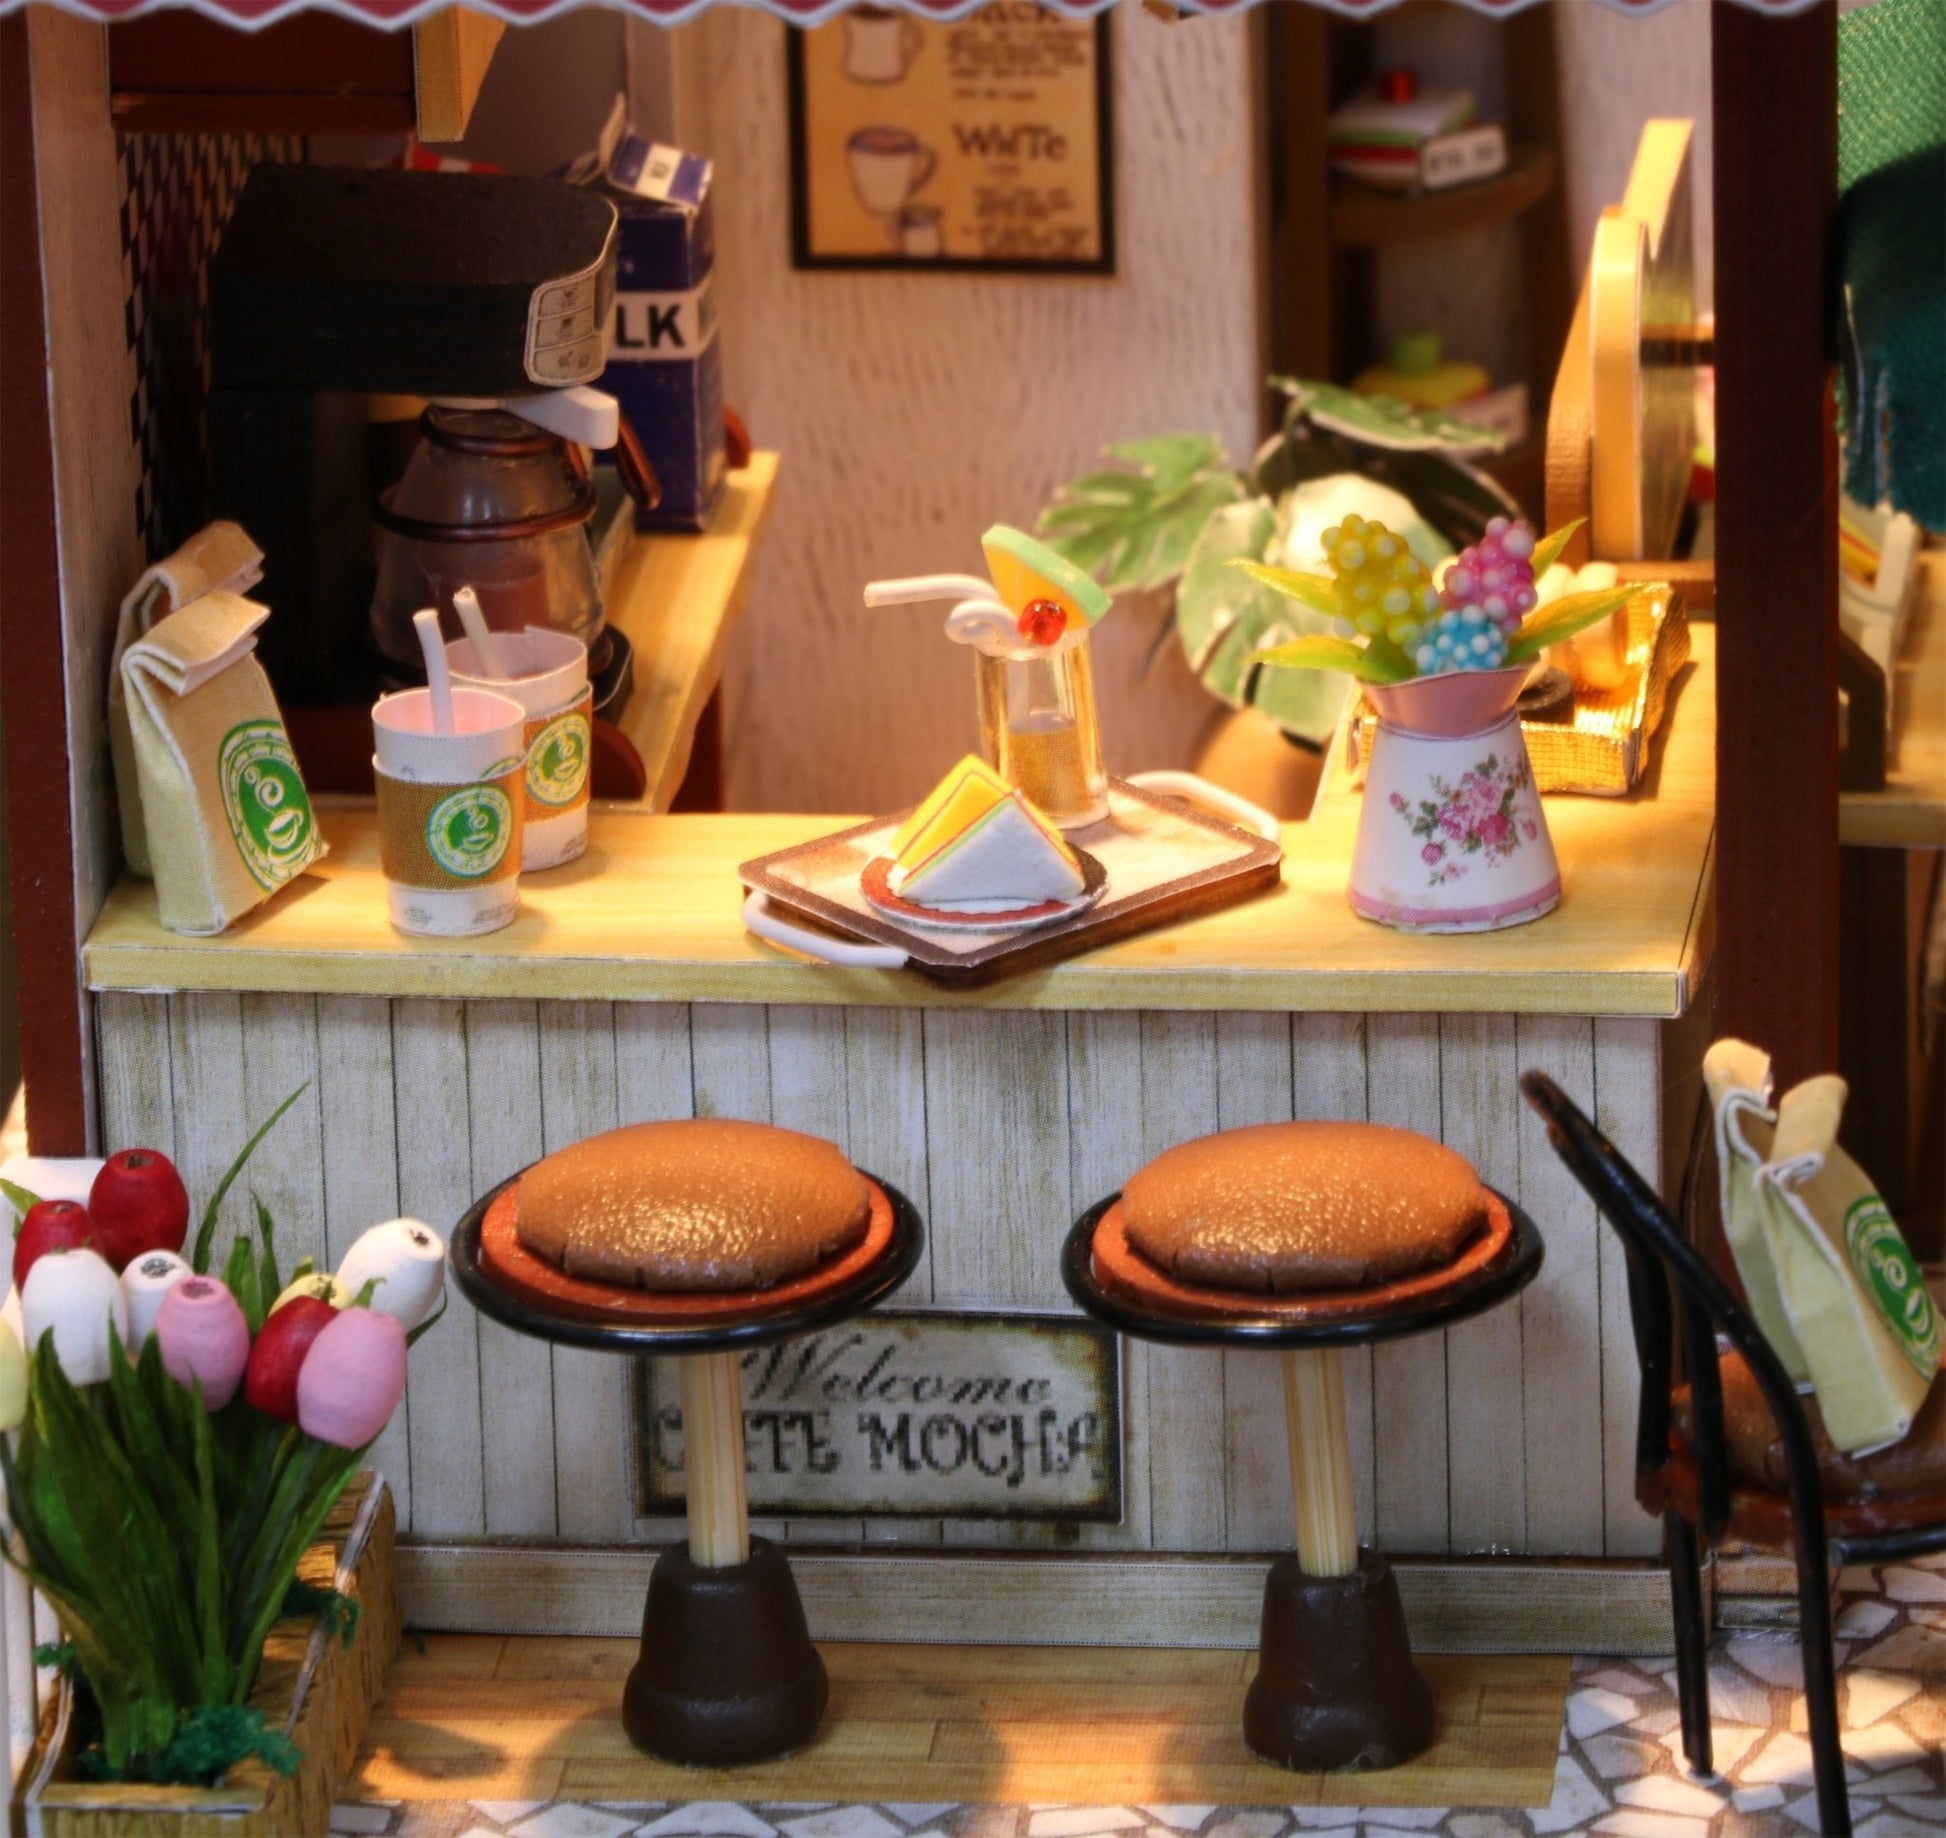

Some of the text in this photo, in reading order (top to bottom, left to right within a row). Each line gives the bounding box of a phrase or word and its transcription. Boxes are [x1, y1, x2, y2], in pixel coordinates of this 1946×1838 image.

[615, 304, 684, 350] LK
[741, 1333, 1051, 1404] Welcome
[857, 1407, 1105, 1487] MOCHA
